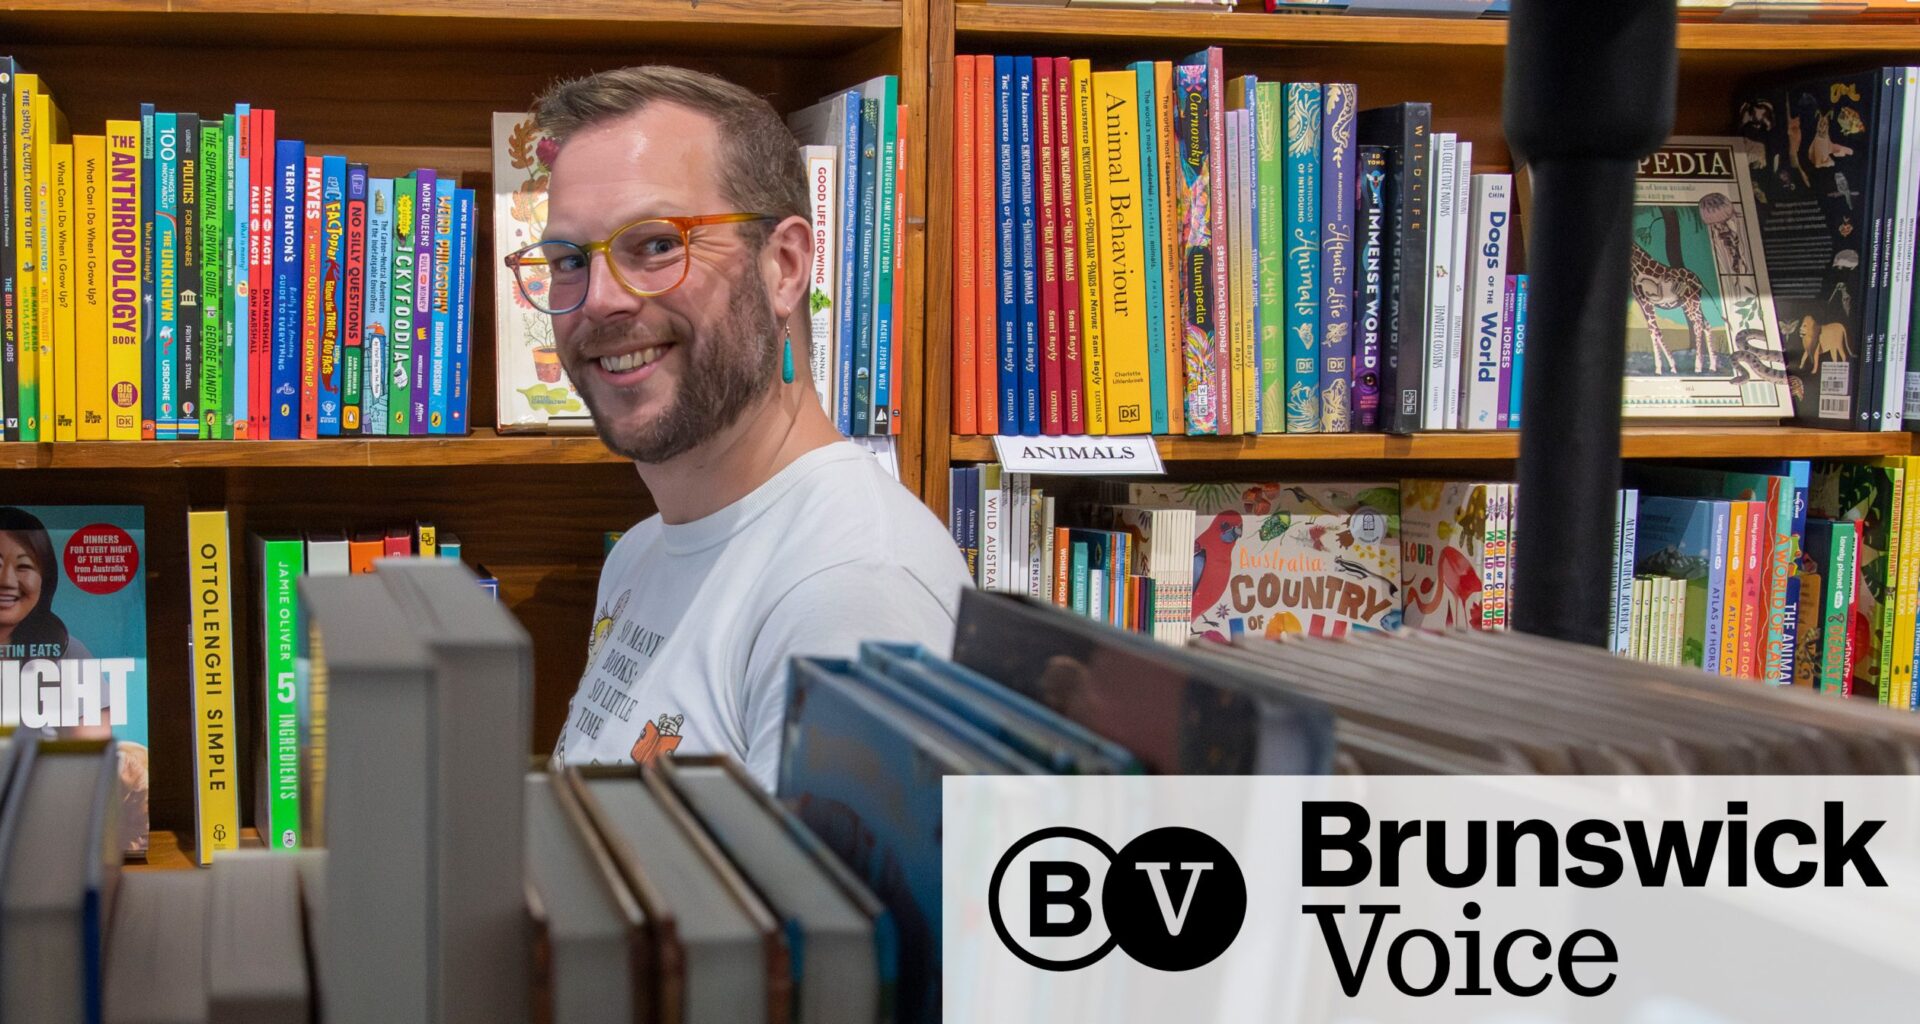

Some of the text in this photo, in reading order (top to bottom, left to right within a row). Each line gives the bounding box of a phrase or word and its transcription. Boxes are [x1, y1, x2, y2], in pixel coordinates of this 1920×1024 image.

[1081, 78, 1089, 93] THE
[112, 135, 135, 148] THE
[160, 127, 176, 160] 100
[1081, 96, 1090, 143] ILLUSTRATED
[1188, 92, 1203, 166] Carnovsky
[21, 90, 33, 248] THE SHORT CURLY GUIDE TO LIFE
[182, 160, 194, 204] POLITICS
[306, 167, 321, 219] HAYES
[1082, 146, 1093, 204] ENCYCLOPAEDIA
[1411, 126, 1423, 229] WILDLIFE
[1440, 139, 1454, 217] 101 COLLECTIVE NOUNS
[86, 159, 97, 305] What Can Do When Grow Up?
[205, 131, 217, 298] THE SUPERNATURAL SURVIVAL GUIDE
[263, 186, 272, 265] FALSE FACTS
[283, 164, 296, 262] TERRY DENTON'S
[352, 207, 362, 228] NO
[420, 183, 431, 246] MONEY QUEENS
[816, 167, 827, 284] GOOD LIFE GROWING
[882, 142, 893, 274] THE UNPLUGGED FAMILY ACTIVITY BOOK
[1086, 207, 1093, 217] OF
[1106, 92, 1134, 317] Animal Behaviour
[112, 152, 136, 332] ANTHROPOLOGY
[184, 226, 192, 266] BEGINNERS
[350, 231, 361, 262] SILLY
[433, 196, 451, 314] WEIRD PHILOSOPHY
[862, 186, 874, 298] Magical Miniature Worlds
[1062, 220, 1074, 281] UGLY ANIMALS
[1085, 218, 1096, 258] PECULIAR
[1217, 245, 1225, 272] BEARS
[1483, 211, 1506, 269] Dogs
[161, 249, 173, 321] UNKNOWN
[1022, 269, 1033, 304] ANIMALS
[1087, 260, 1097, 287] PAIRS
[1193, 254, 1205, 324] Illumipedia
[1218, 275, 1226, 302] POLAR
[1290, 228, 1317, 315] Animals
[1323, 223, 1350, 318] Aquatic Life
[1364, 193, 1380, 368] AN IMMENSE WORLD
[1487, 276, 1495, 304] OF THE
[5, 277, 14, 362] THE BIG BOOK OF JOBS
[305, 243, 317, 387] HOW TO OUTSMART GROWN-UP
[348, 267, 361, 339] QUESTIONS
[393, 246, 413, 361] ICKYFOODIA
[1090, 299, 1098, 329] NATURE
[112, 336, 136, 345] BOOK
[1478, 312, 1497, 382] World
[1501, 326, 1511, 368] HORSES
[1515, 324, 1525, 354] DOGS
[1022, 446, 1135, 460] ANIMALS
[70, 546, 132, 554] FOR EVERY NIGHT
[83, 535, 119, 544] DINNERS
[986, 497, 996, 590] WILD AUSTRAL
[1889, 480, 1902, 577] EXTRAORDINARY ELEPHANTS
[74, 565, 128, 573] from Australia's
[77, 574, 126, 583] favourite cook
[78, 555, 125, 564] OF THE WEEK
[1493, 529, 1505, 625] WORLD COLOUR
[1621, 518, 1634, 634] AMAZING ANIMAL JOURNEYS
[1835, 536, 1847, 589] lonely planet
[279, 561, 291, 660] JAMIE OLIVER
[1230, 573, 1392, 622] COUNTRY
[1248, 615, 1264, 631] OF
[1710, 588, 1720, 621] ATLAS
[1768, 533, 1789, 680] A WORLD OF CATS
[29, 644, 61, 657] EATS
[617, 620, 664, 658] SO MANY
[1709, 625, 1717, 636] of
[1825, 625, 1842, 678] DEADLY
[0, 658, 135, 728] IGHT
[201, 544, 225, 790] OTTOLENGHI SIMPLE
[277, 672, 295, 703] 5
[575, 707, 604, 740] TIME
[588, 678, 638, 722] SO LITTLE
[279, 714, 296, 799] INGREDIENTS
